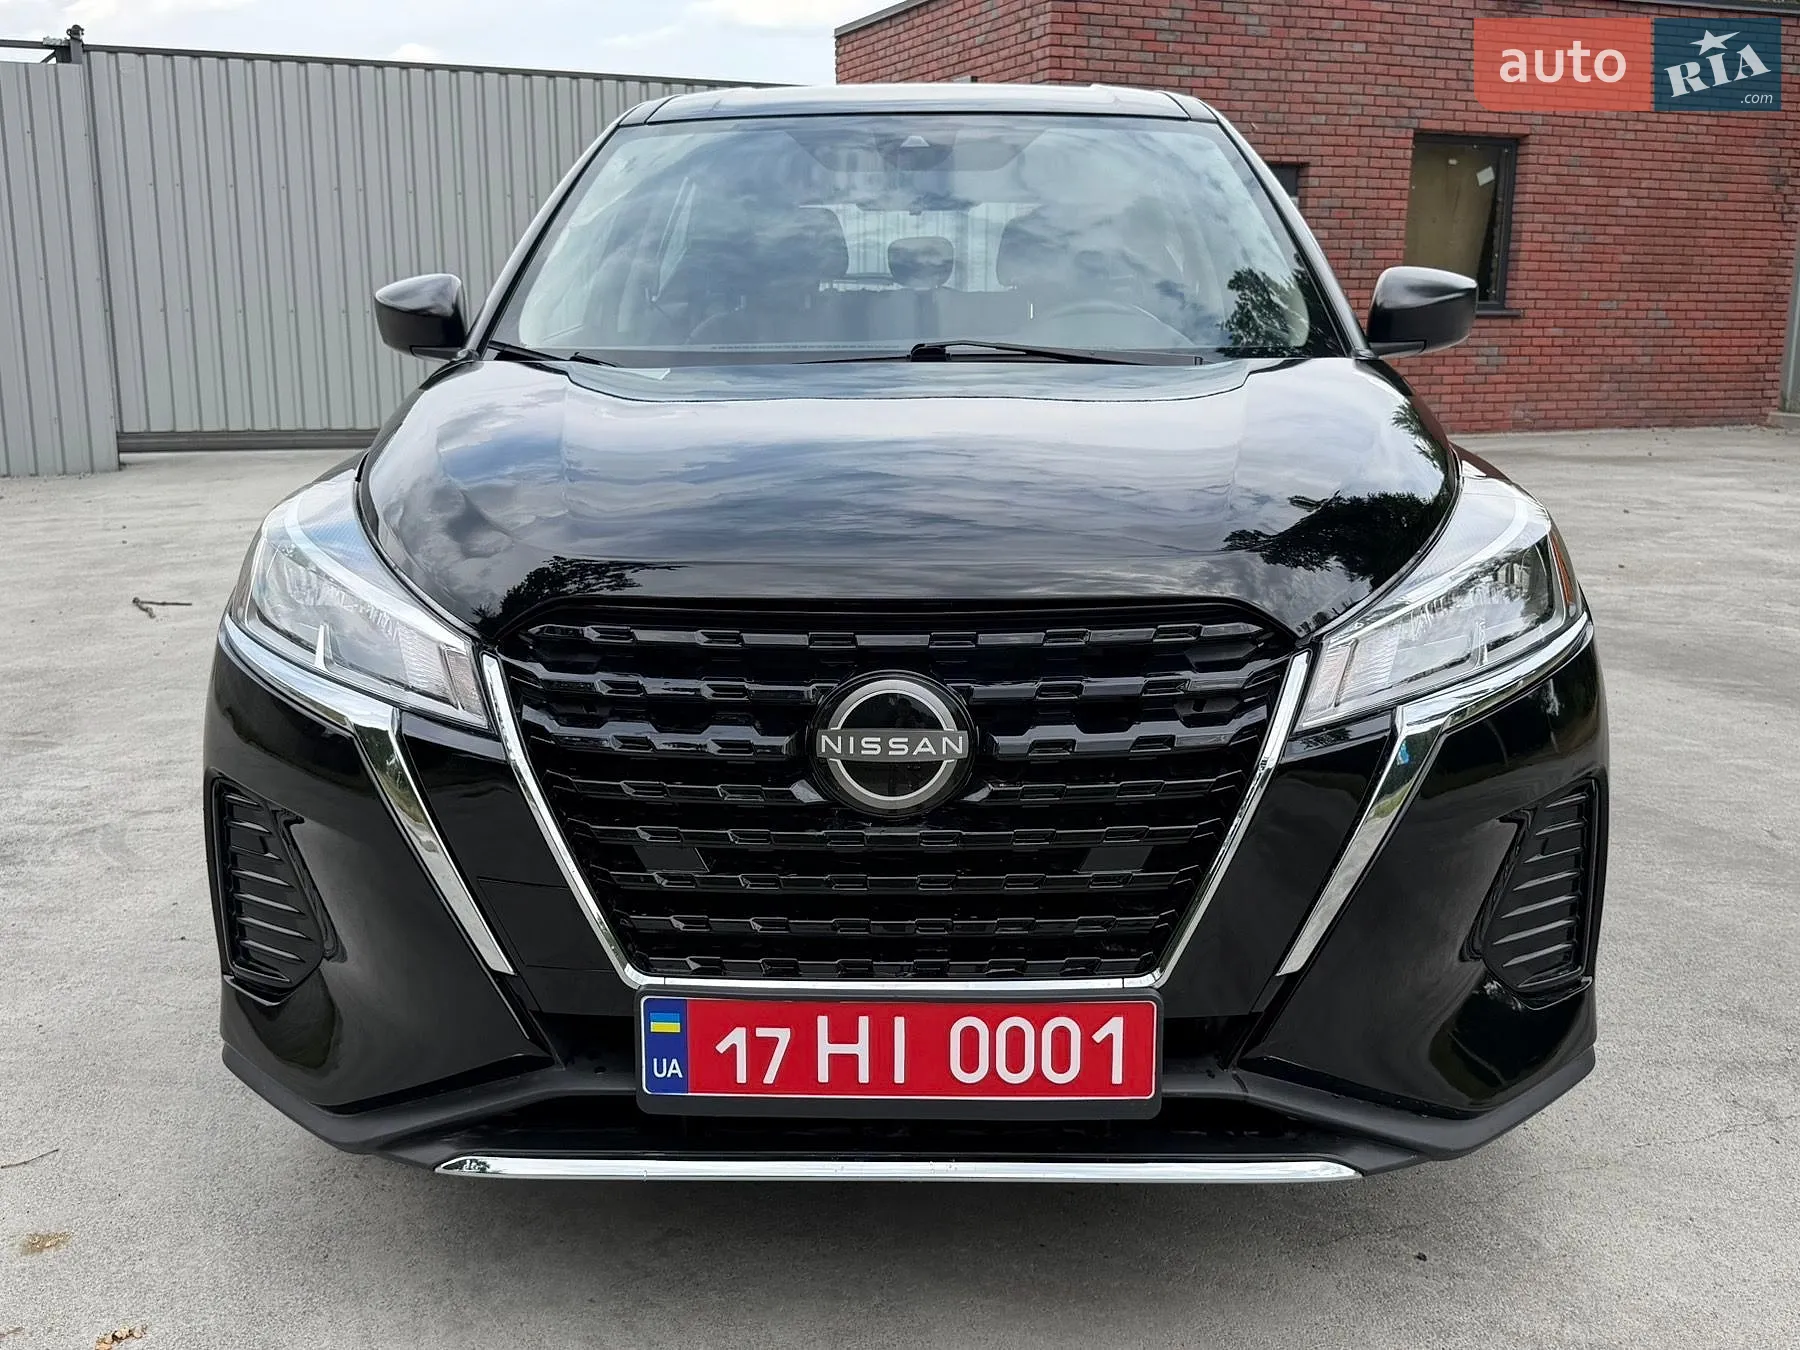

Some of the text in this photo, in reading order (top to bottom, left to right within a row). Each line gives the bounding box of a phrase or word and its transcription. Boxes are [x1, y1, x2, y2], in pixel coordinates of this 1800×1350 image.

[821, 735, 963, 755] NISSAN
[715, 1016, 1124, 1084] 17 HI 0001
[653, 1058, 683, 1078] UA
